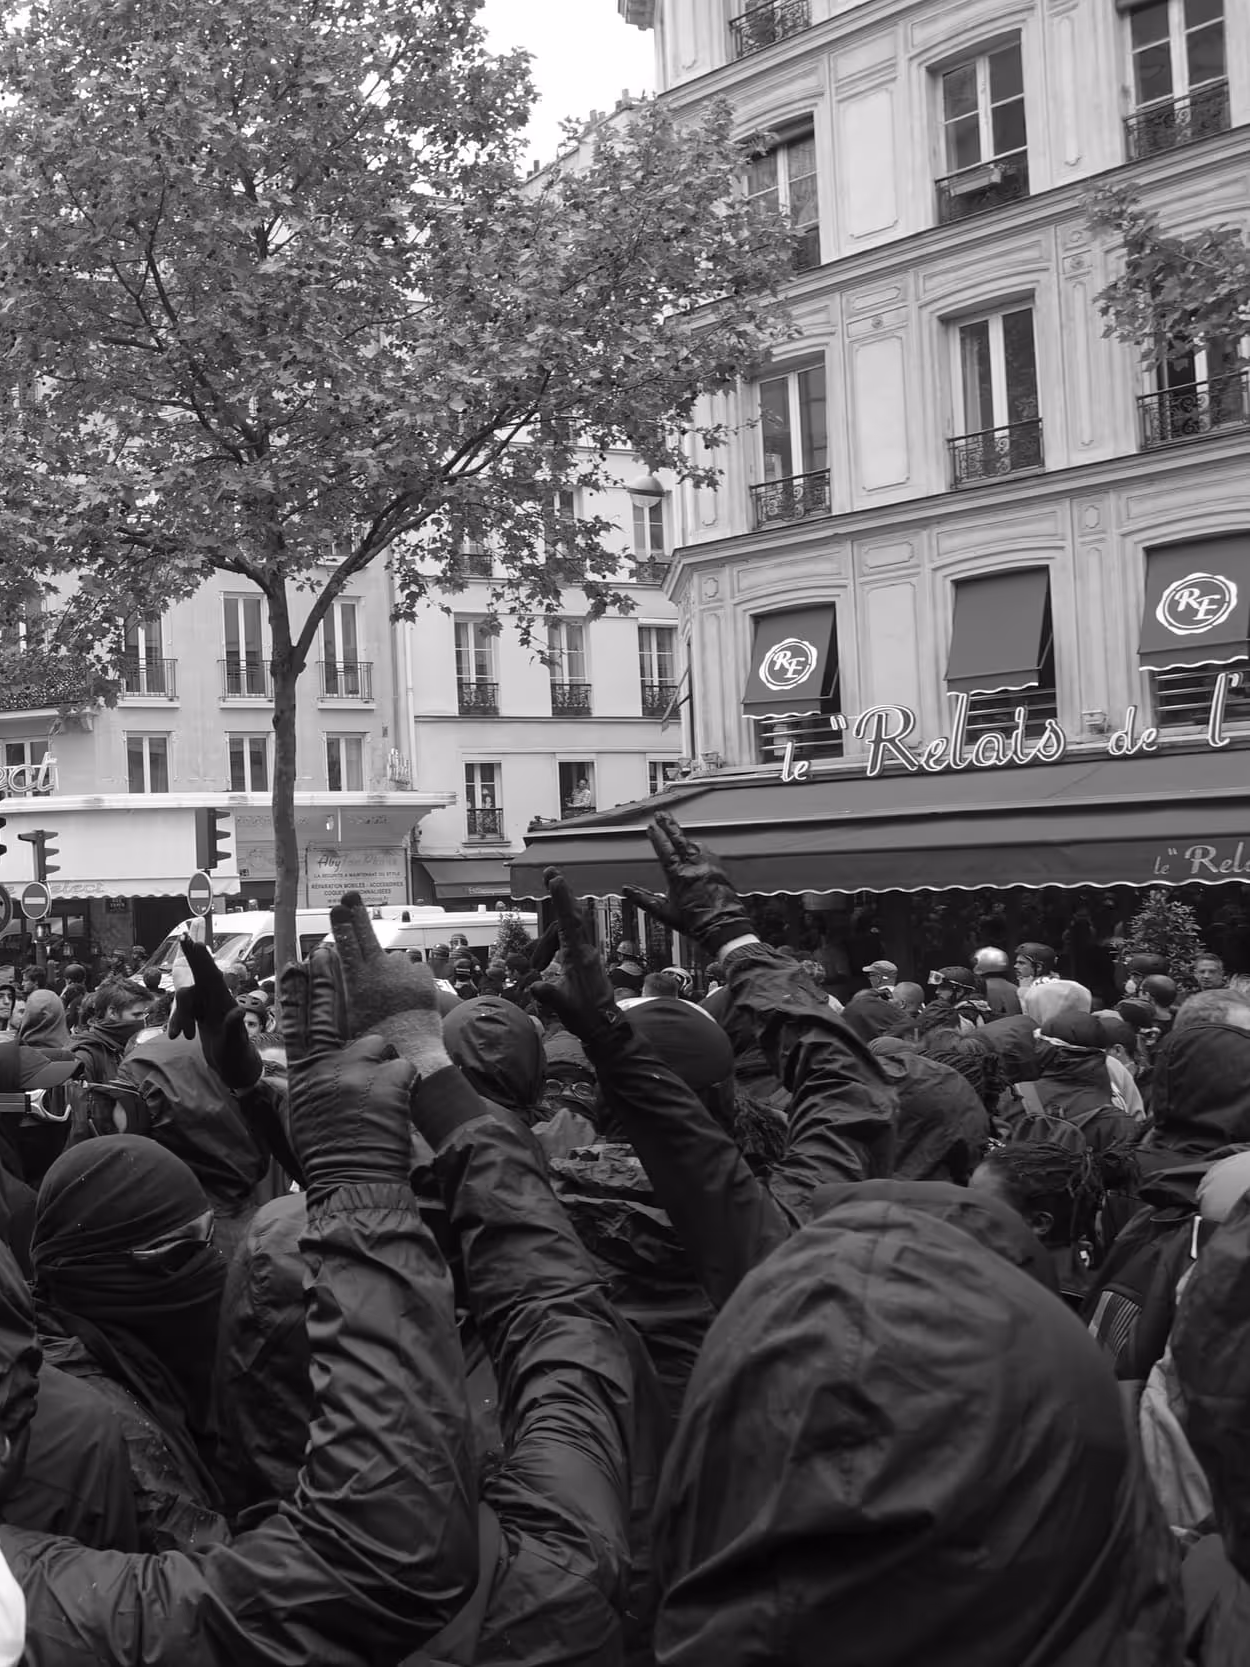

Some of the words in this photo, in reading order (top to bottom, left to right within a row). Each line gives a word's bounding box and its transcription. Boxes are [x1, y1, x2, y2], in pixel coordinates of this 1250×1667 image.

[1175, 587, 1222, 621] RE
[773, 650, 807, 680] RE
[779, 742, 812, 782] le
[1108, 705, 1158, 757] de
[1154, 856, 1170, 874] le
